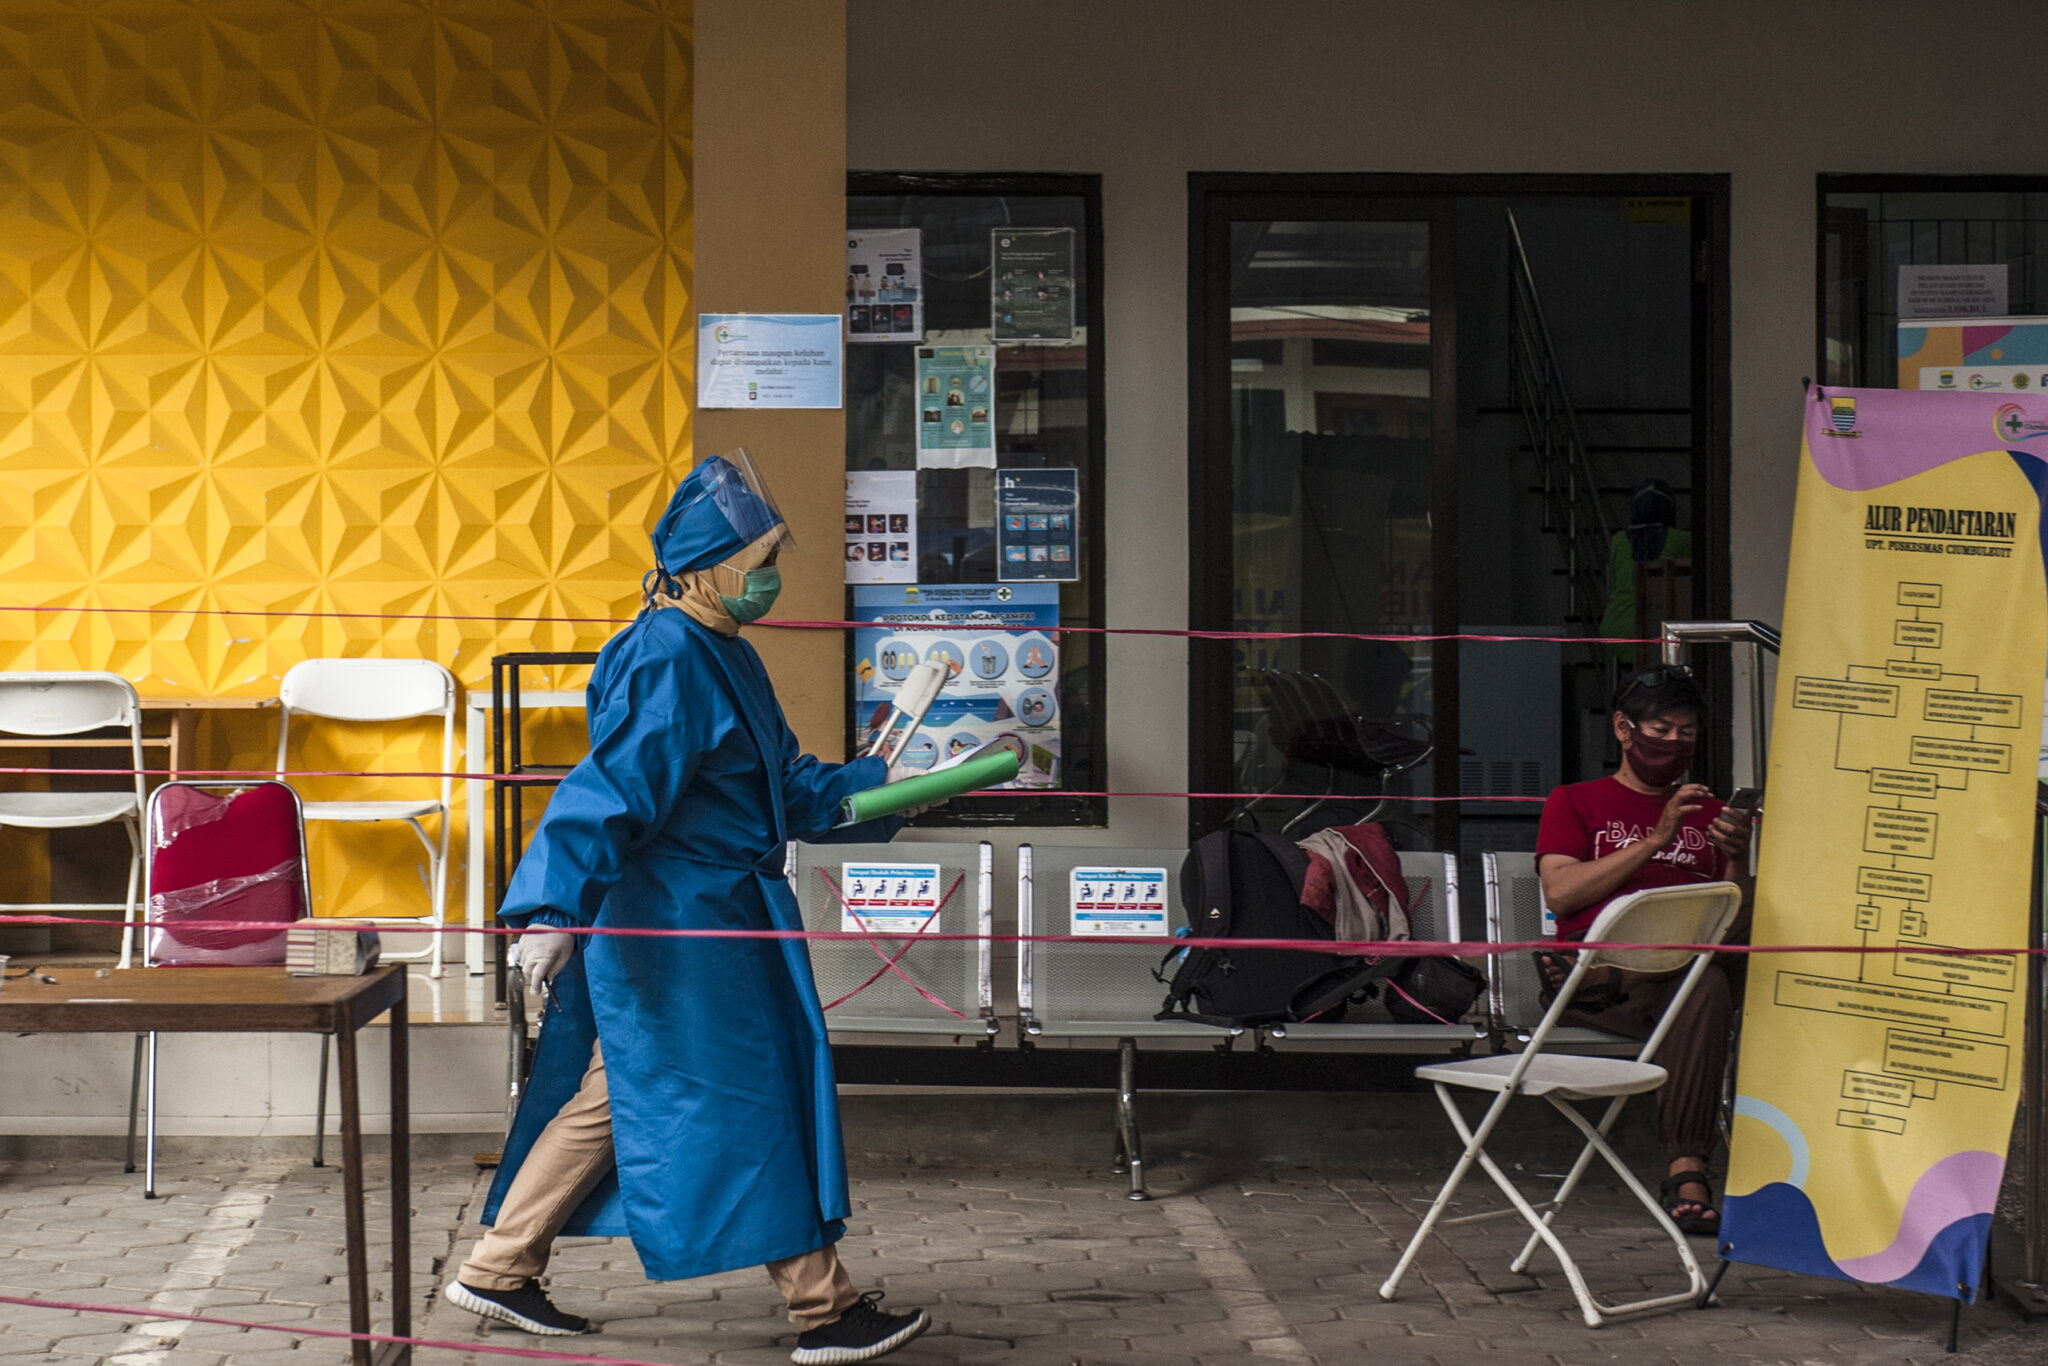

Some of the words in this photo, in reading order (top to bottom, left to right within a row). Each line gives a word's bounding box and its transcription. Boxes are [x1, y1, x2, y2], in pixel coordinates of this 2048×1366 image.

[1863, 504, 1902, 532] ALUR
[1905, 506, 2017, 538] PENDAFTARAN
[1888, 540, 1944, 554] PUSKESMAS
[1945, 544, 2013, 558] CIUMBULEUIT
[883, 613, 933, 622] PROTOKOL
[934, 613, 996, 622] KEDATANGAN
[998, 612, 1035, 621] SAMPAI
